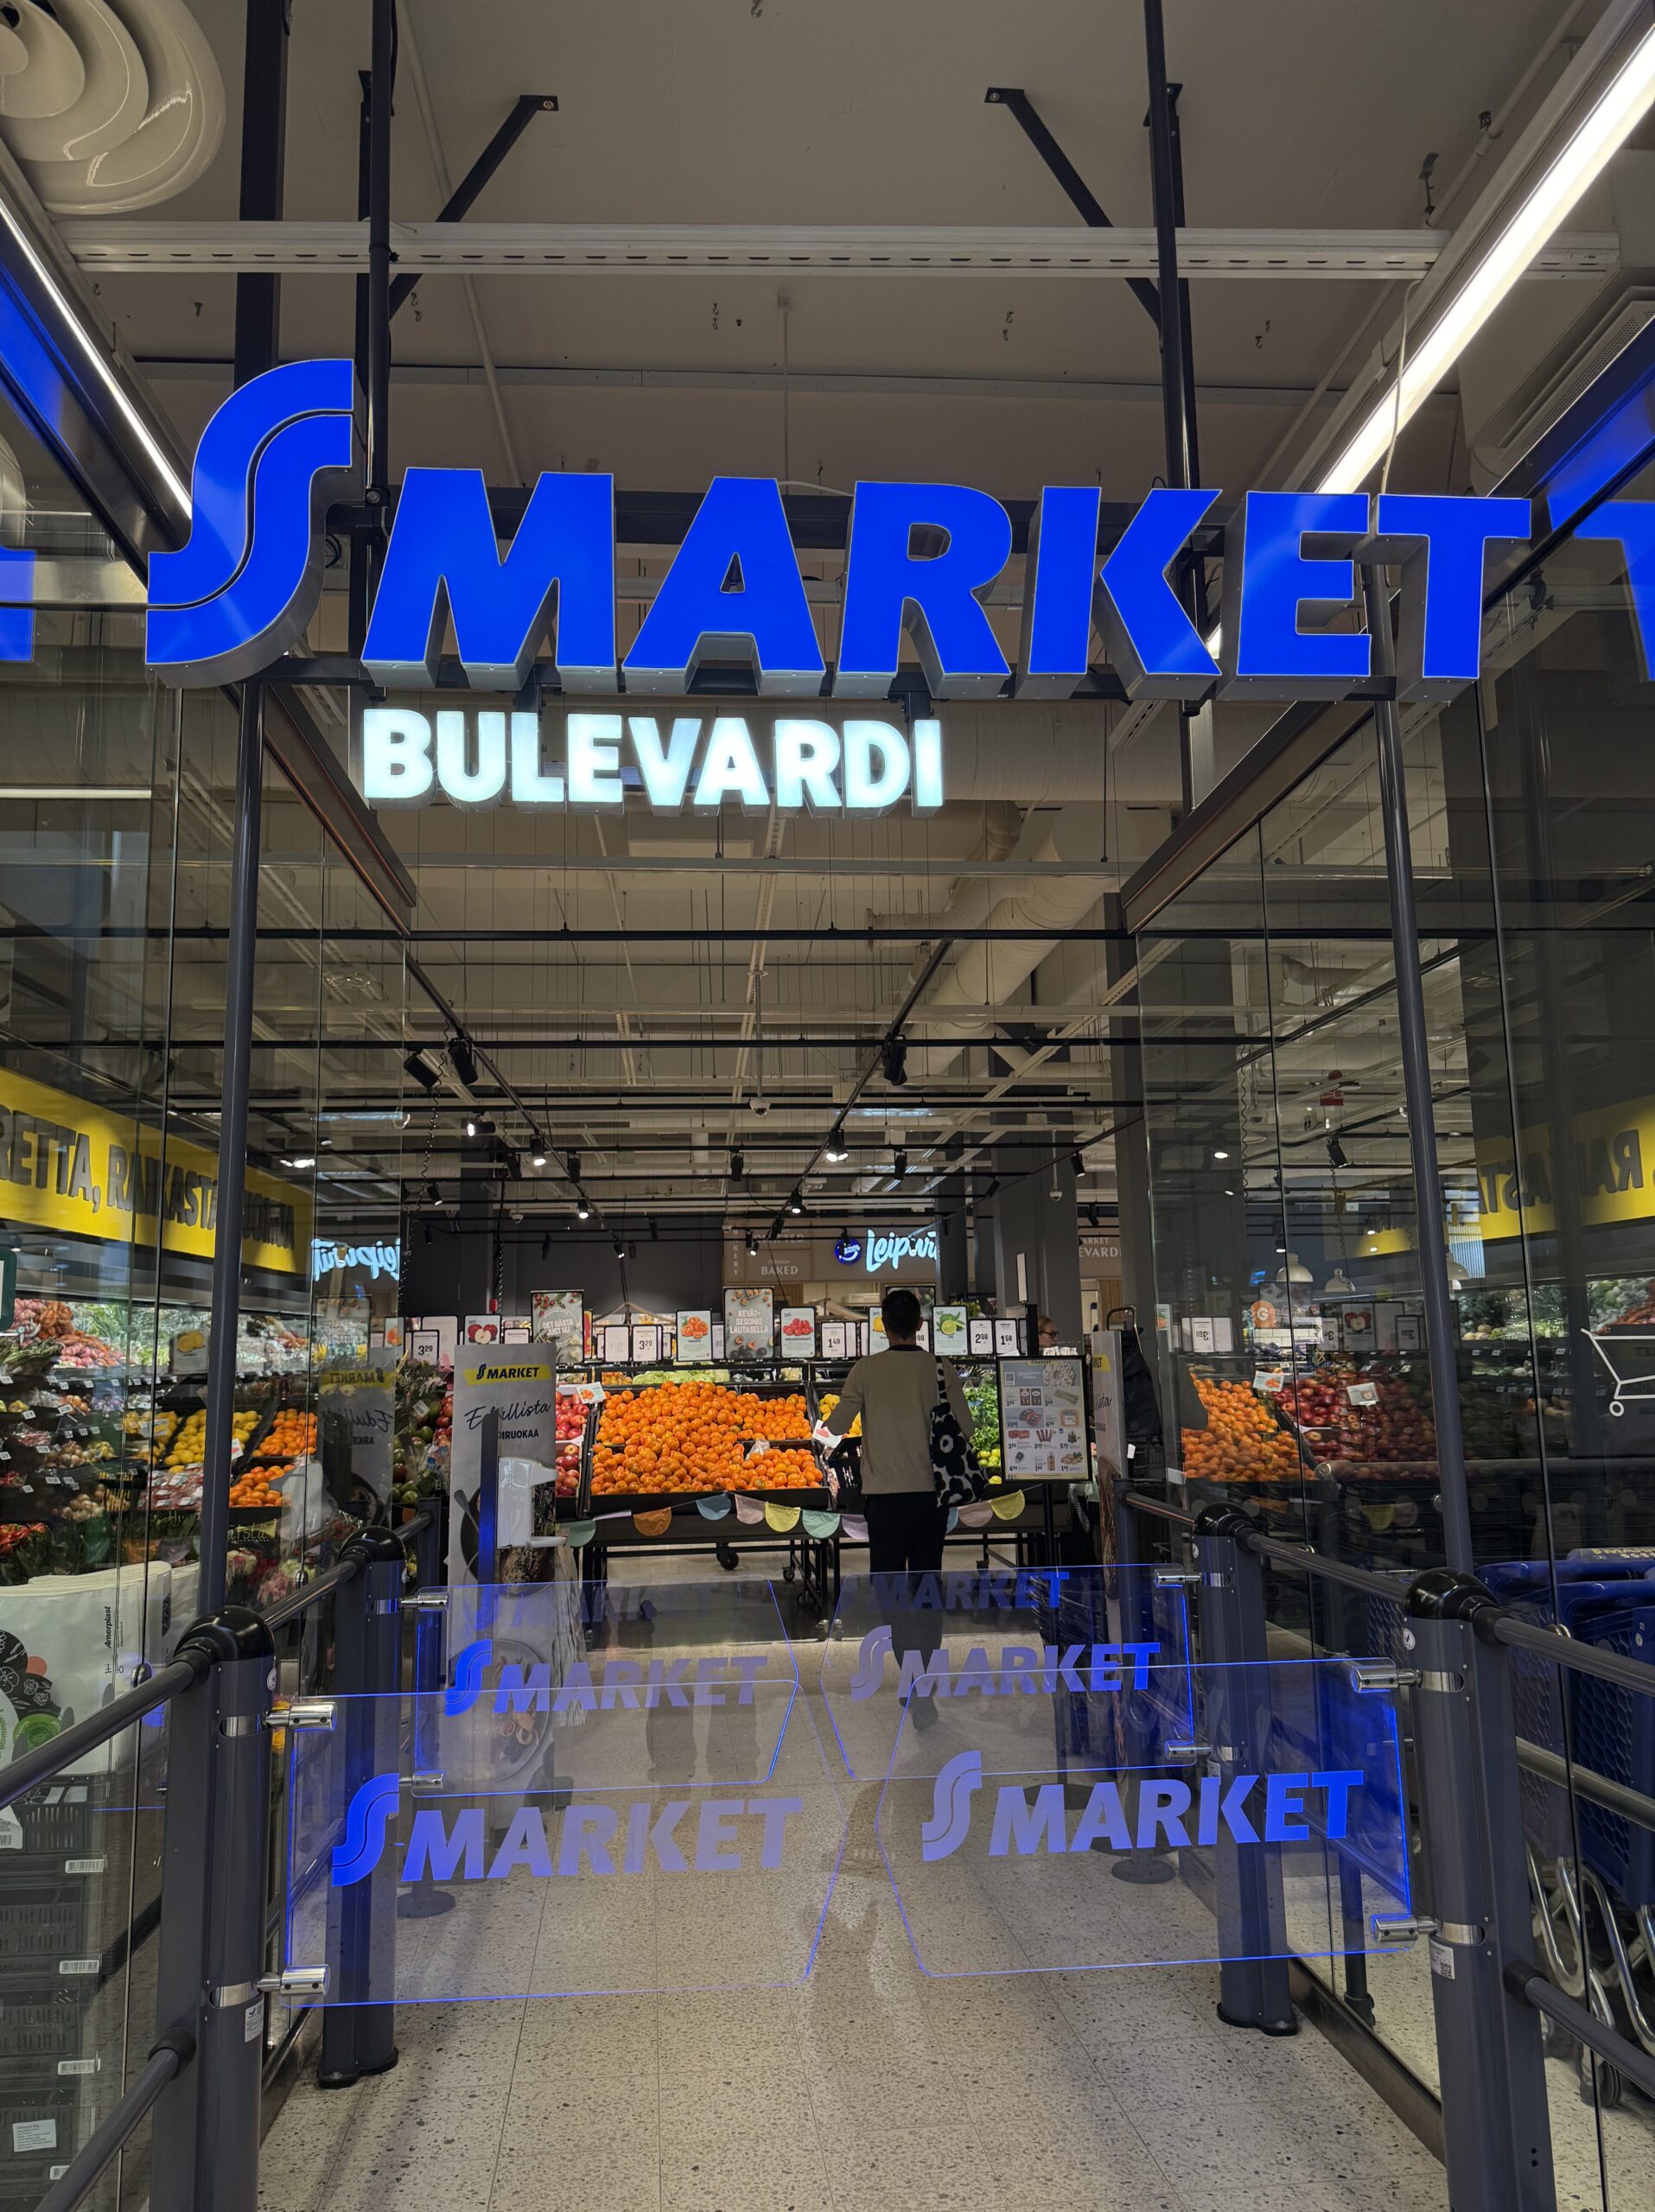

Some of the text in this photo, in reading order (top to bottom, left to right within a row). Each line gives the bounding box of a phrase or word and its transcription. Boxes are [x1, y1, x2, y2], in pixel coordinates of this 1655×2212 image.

[360, 466, 1533, 681] MARKET
[363, 709, 944, 810] BULEVARDI
[761, 1266, 799, 1275] BAKED
[729, 1325, 769, 1335] LAUTASELLA
[487, 1367, 540, 1380] MARKET
[104, 1605, 113, 1649] Amerplast
[493, 1656, 769, 1713] MARKET
[897, 1642, 1162, 1699] MARKET
[401, 1796, 804, 1882] MARKET
[988, 1770, 1365, 1856] MARKET
